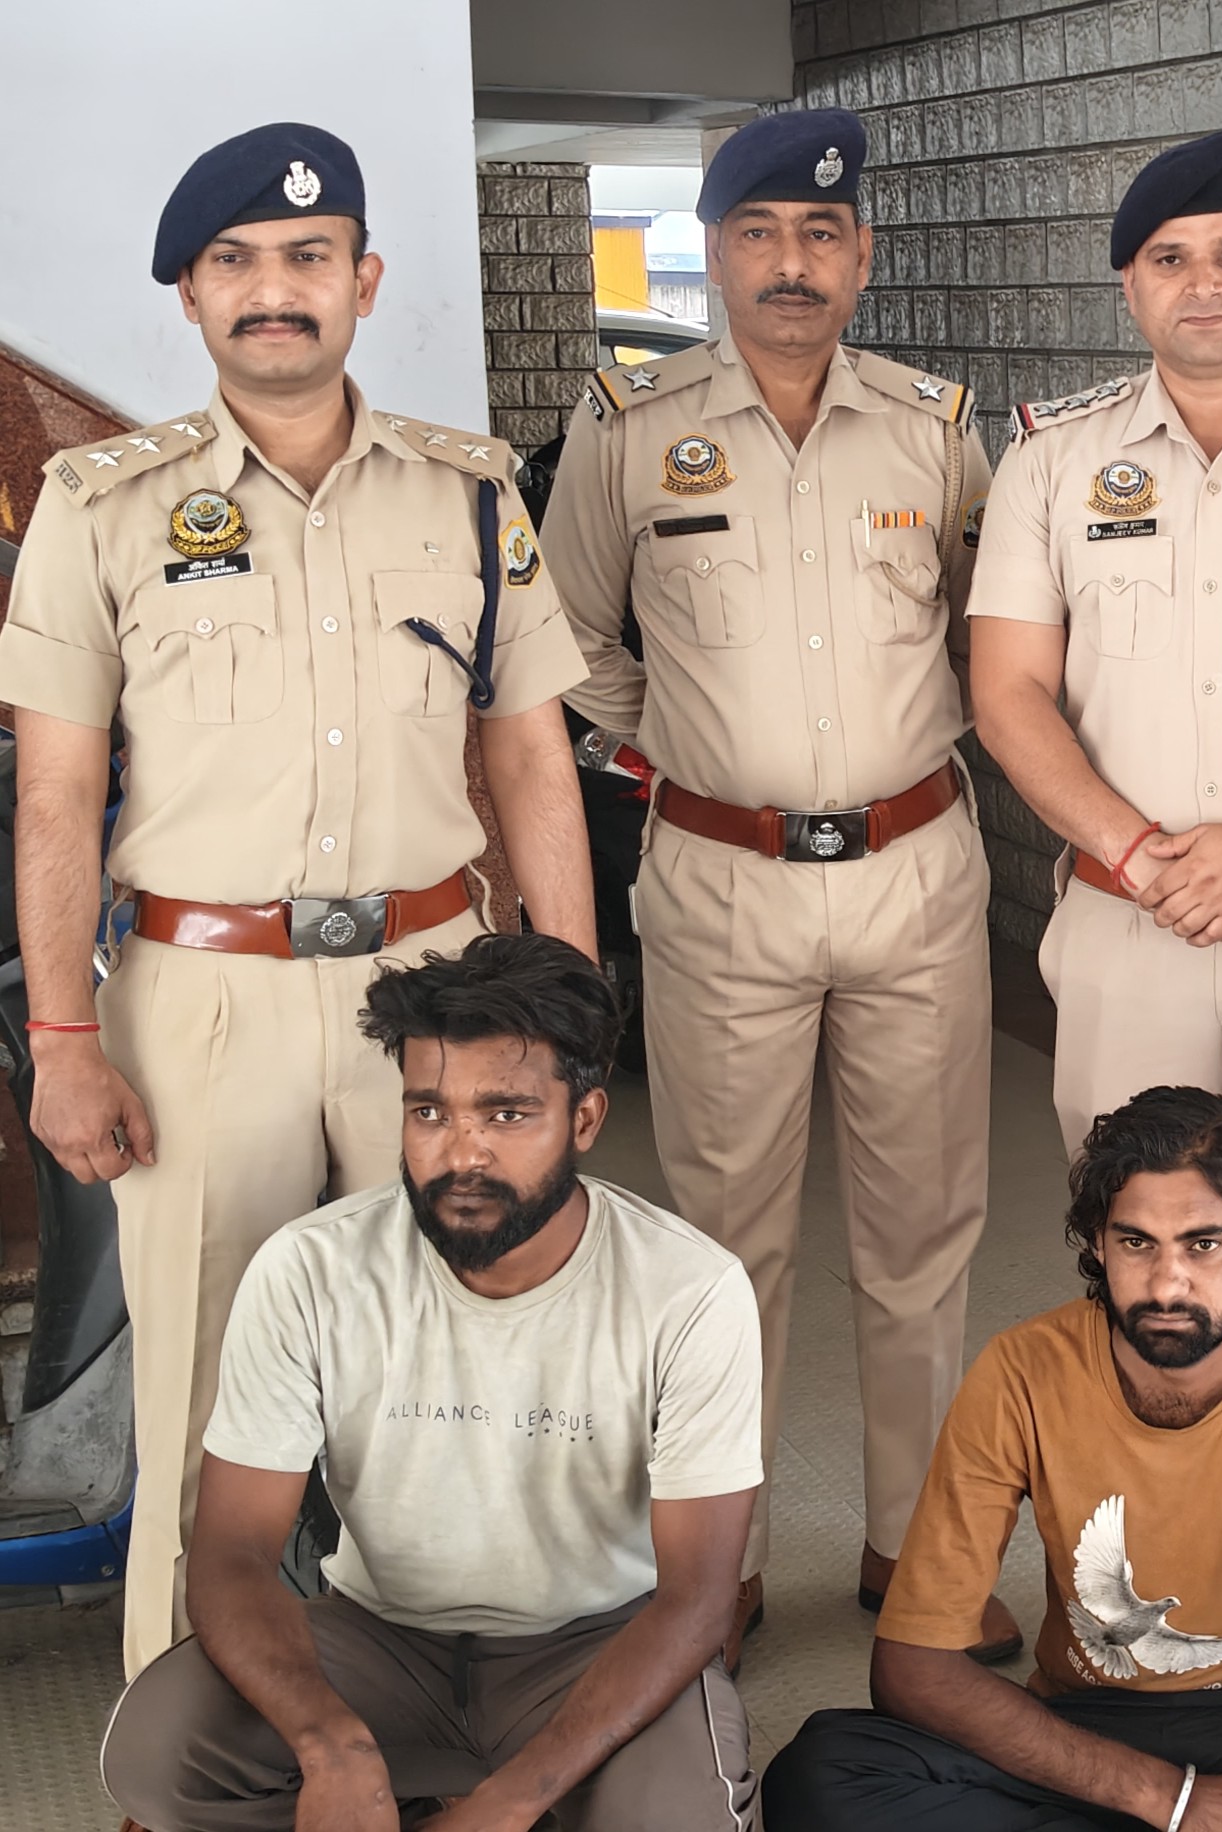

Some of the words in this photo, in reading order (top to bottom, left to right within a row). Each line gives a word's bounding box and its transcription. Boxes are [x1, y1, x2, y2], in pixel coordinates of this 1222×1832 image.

[178, 571, 202, 580] ANKIT
[204, 566, 239, 577] SHARMA
[386, 1402, 490, 1426] ALLIANCE
[516, 1407, 593, 1431] LEAGUE
[1066, 1646, 1084, 1675] RISE
